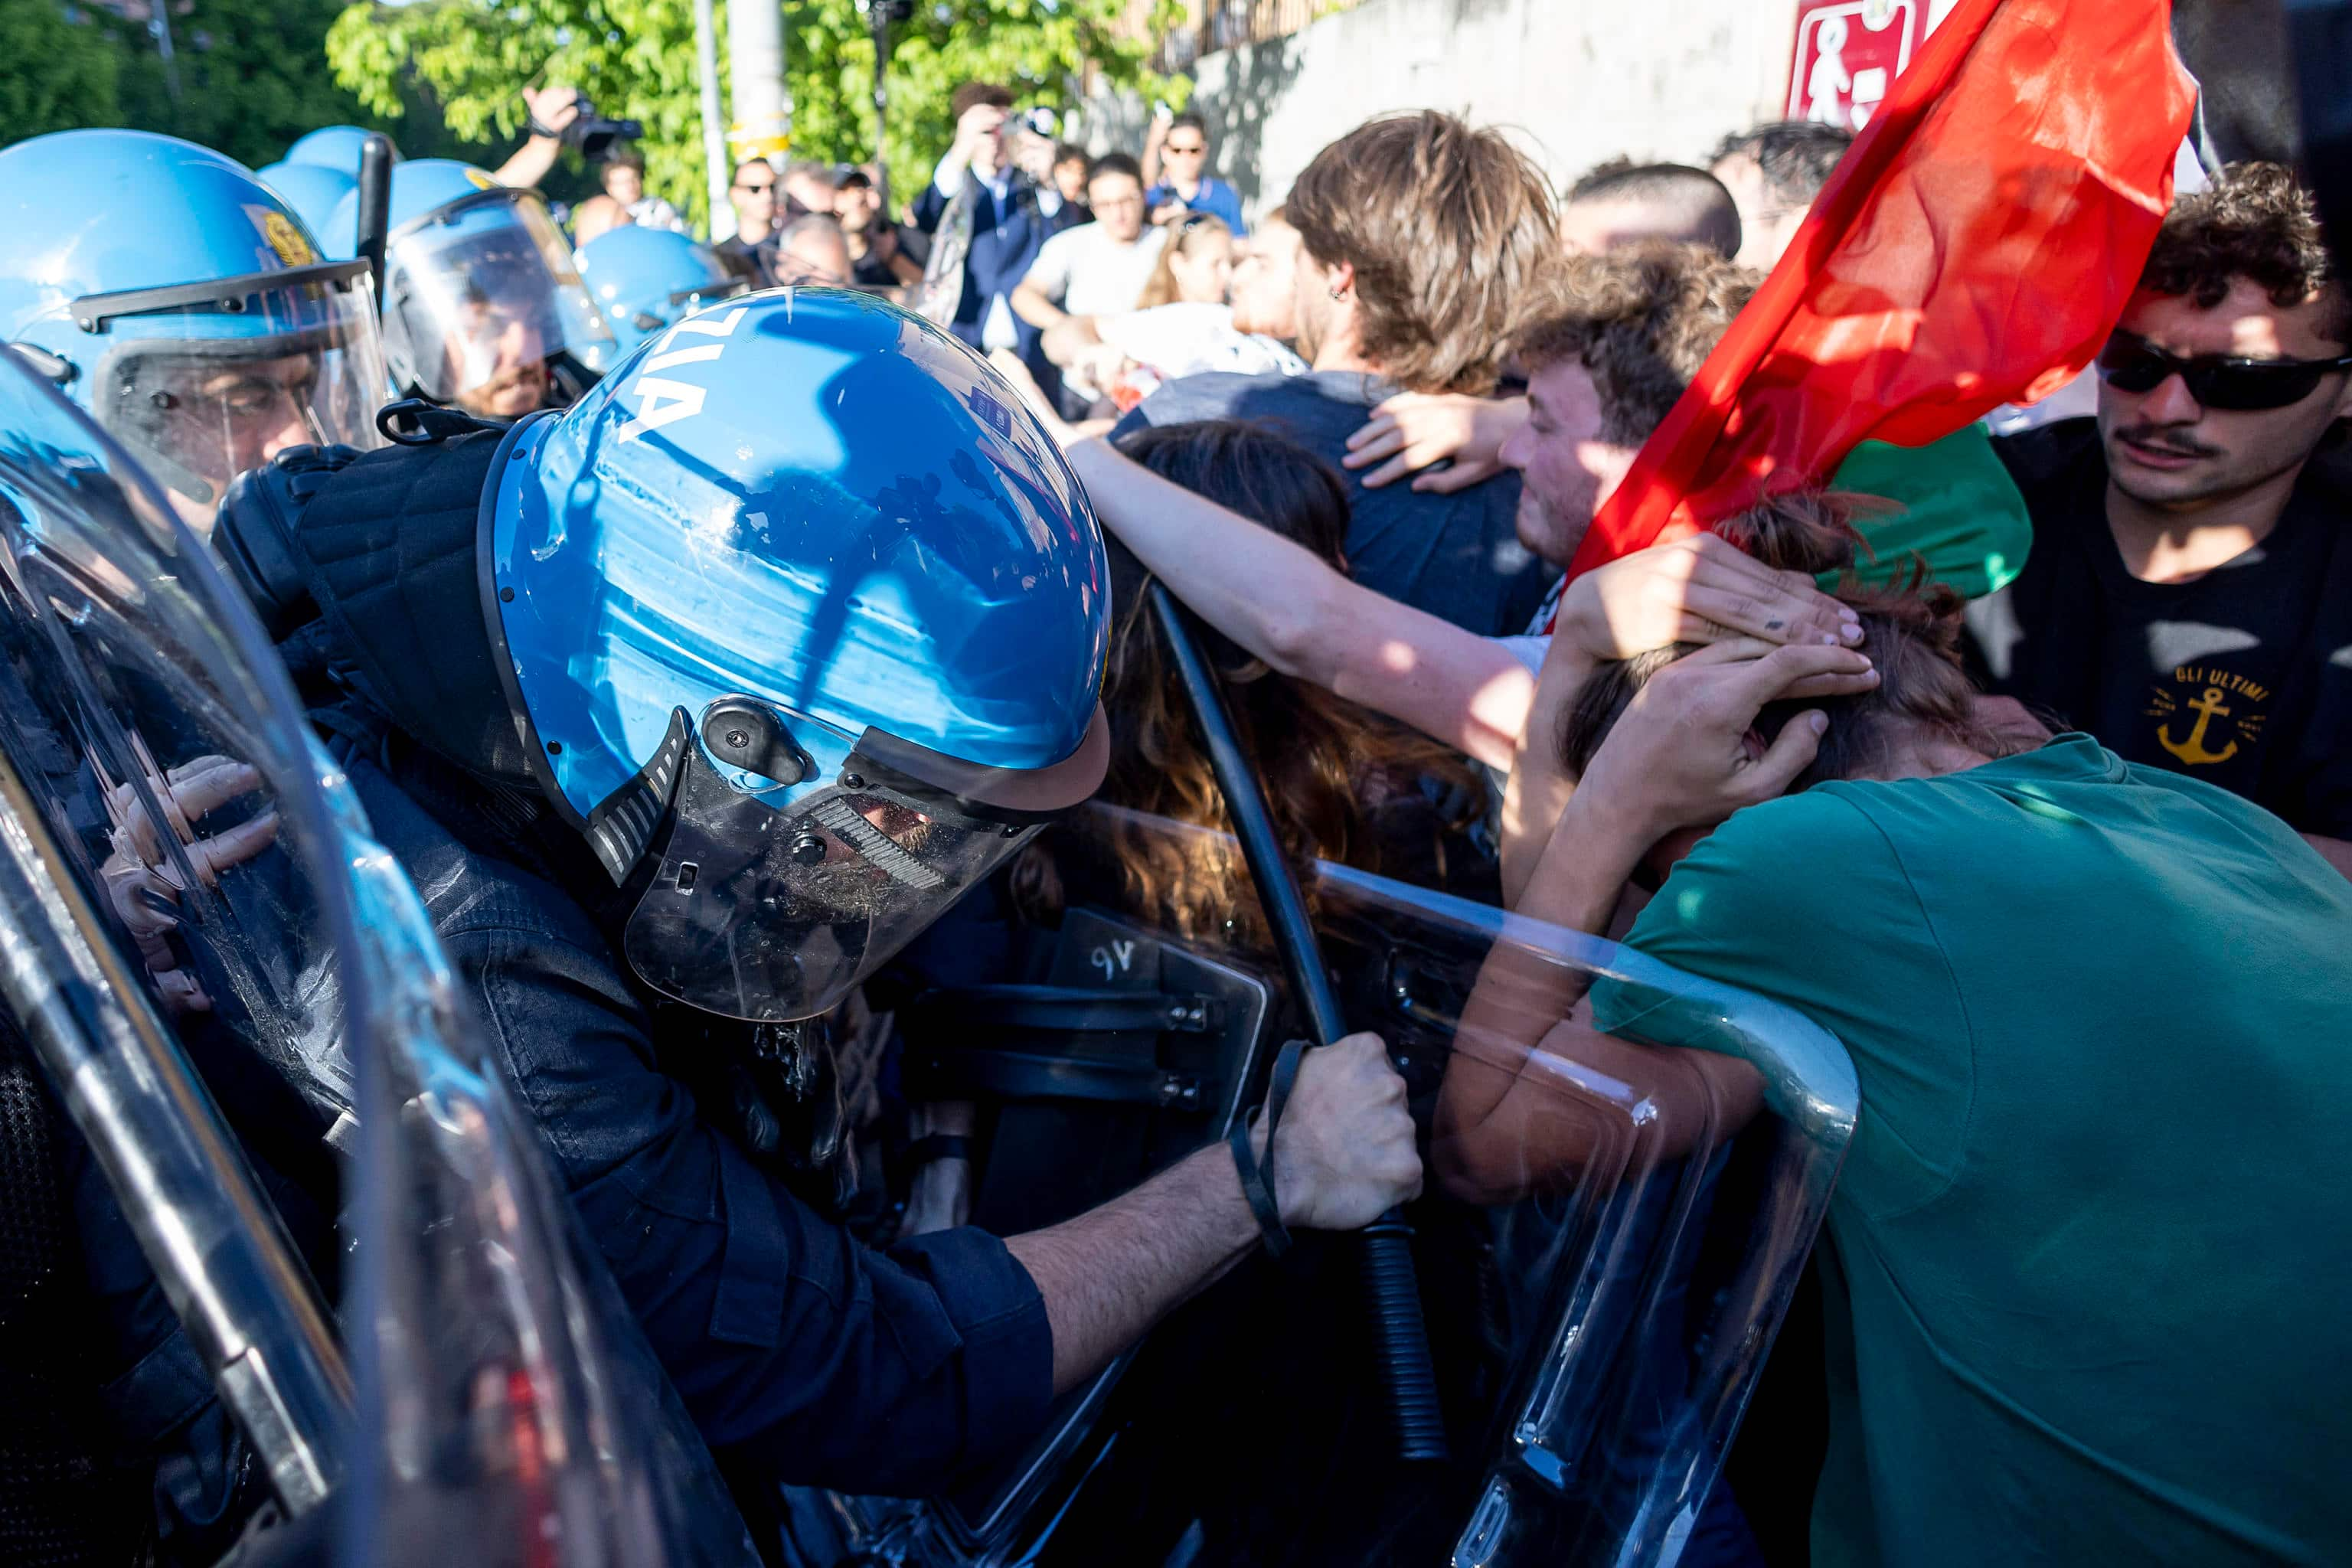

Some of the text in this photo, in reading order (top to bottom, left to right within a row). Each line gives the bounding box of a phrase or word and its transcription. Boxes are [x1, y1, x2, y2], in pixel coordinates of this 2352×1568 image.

[618, 303, 750, 446] ZIA
[2175, 666, 2269, 703] GLI ULTIMI
